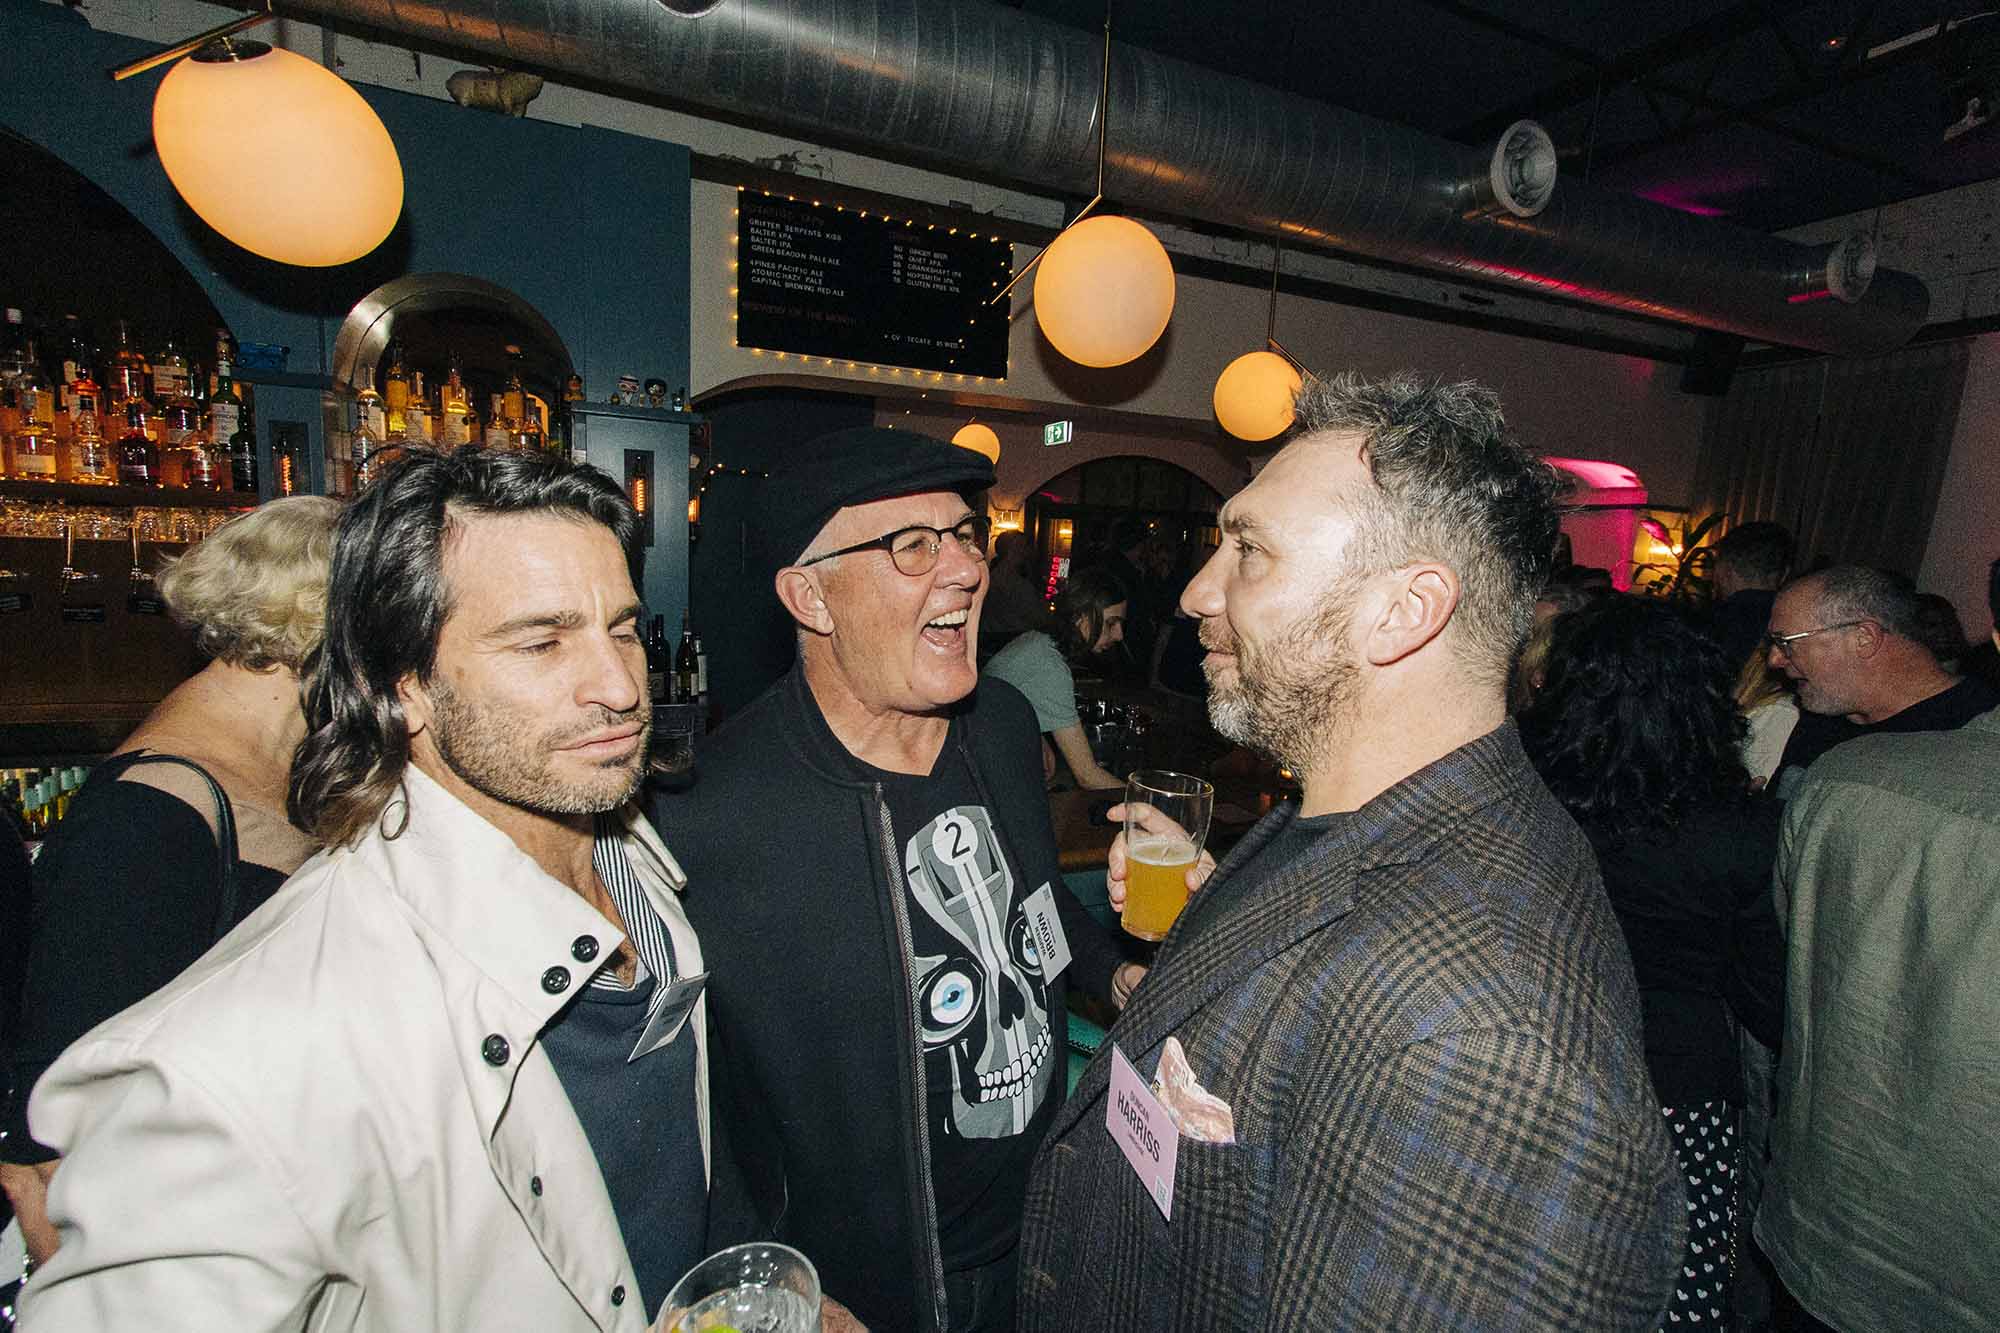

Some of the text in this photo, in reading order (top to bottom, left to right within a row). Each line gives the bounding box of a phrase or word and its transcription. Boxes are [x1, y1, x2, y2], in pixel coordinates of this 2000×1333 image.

[749, 218, 780, 230] GRIFTER
[784, 225, 822, 238] SERPENTS
[750, 227, 776, 238] BALTER
[751, 235, 792, 249] BALTER IPA
[751, 244, 841, 266] GREEN BEACON PALE ALE
[751, 268, 780, 279] ATOMIC
[805, 277, 822, 286] PALE
[778, 264, 808, 275] PACIFIC
[811, 270, 824, 278] ALE
[751, 276, 845, 297] CAPITAL BREWING RED ALE
[906, 279, 931, 289] GLUTEN
[944, 821, 970, 859] 2
[1036, 912, 1056, 960] BROWN
[1117, 1089, 1161, 1163] HARRISS
